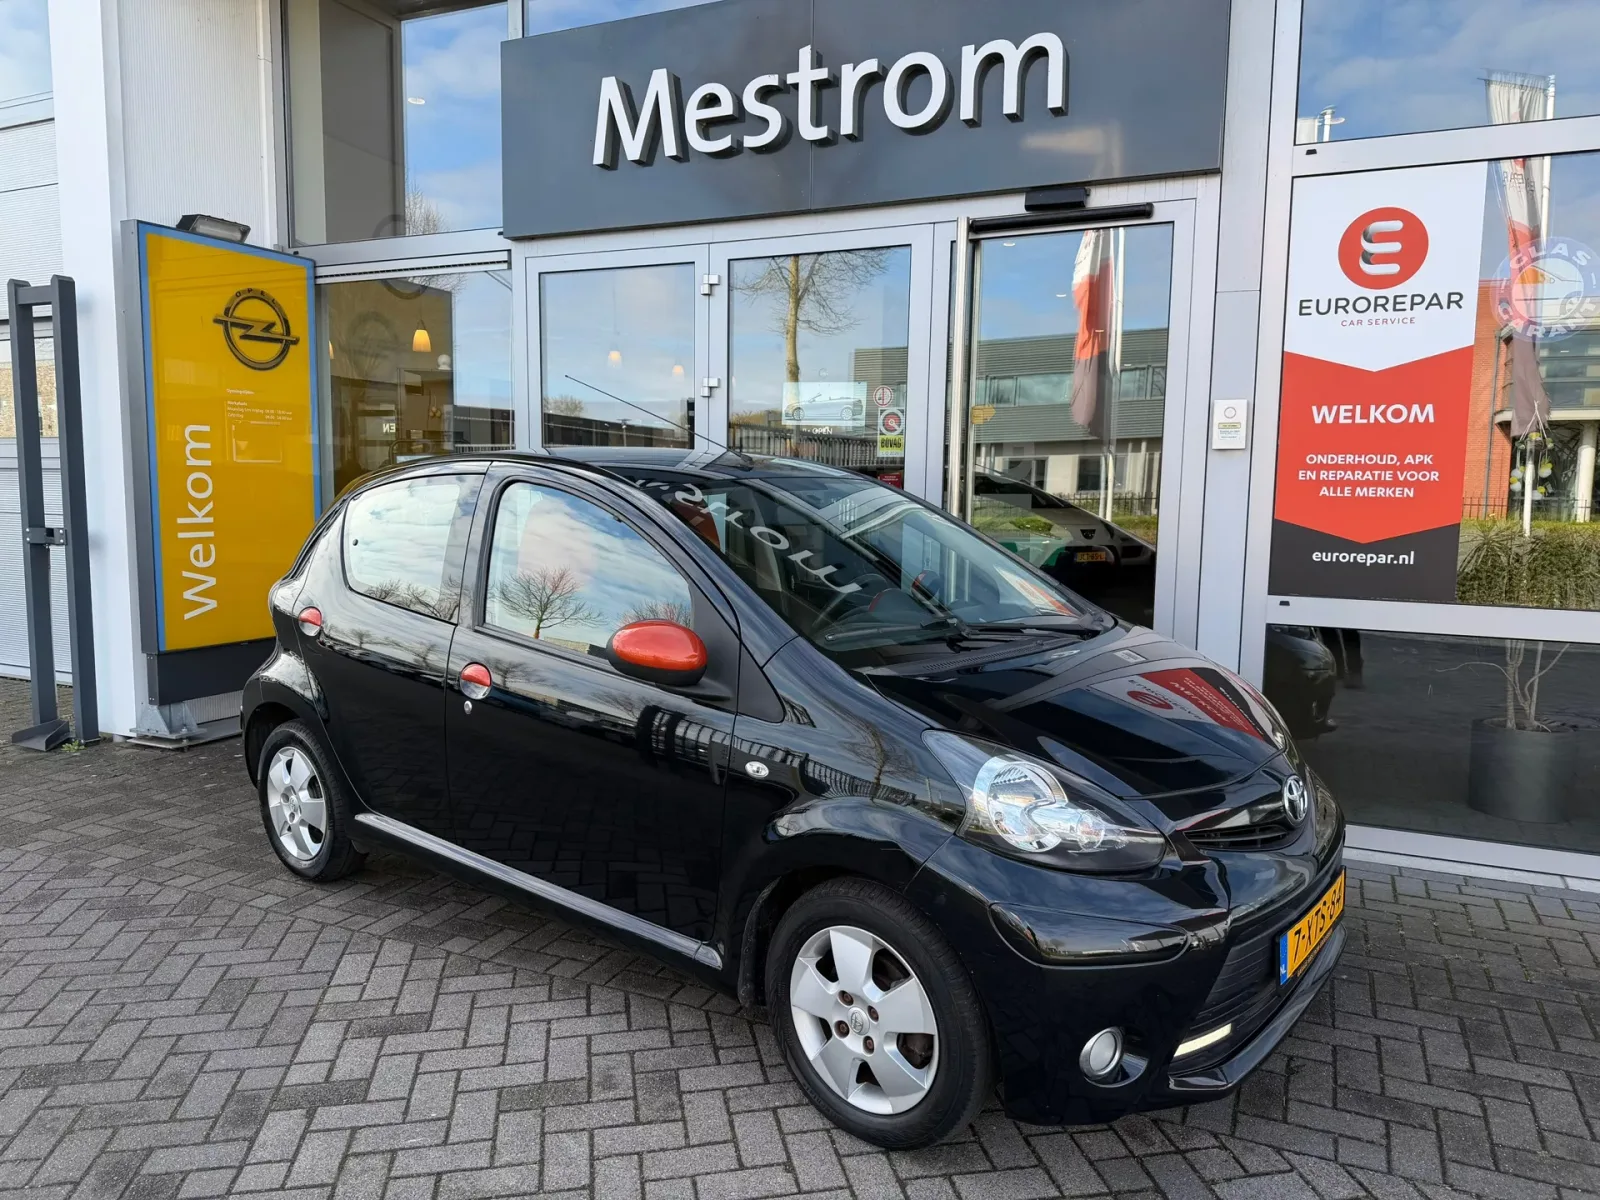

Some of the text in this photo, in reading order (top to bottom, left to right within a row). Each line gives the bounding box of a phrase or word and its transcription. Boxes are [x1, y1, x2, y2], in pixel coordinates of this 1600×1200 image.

[592, 32, 1067, 170] Mestrom
[1510, 243, 1591, 269] GLAS
[235, 287, 276, 304] OPEL
[1299, 292, 1464, 316] EUROREPAR
[1341, 317, 1416, 327] CAR SERVICE
[1311, 404, 1435, 424] WELKOM
[881, 438, 902, 448] BOVAG
[1306, 454, 1433, 466] ONDERHOUD, APK
[1298, 470, 1439, 481] EN REPARATIE VOOR
[1319, 486, 1414, 498] ALLE MERKEN
[176, 424, 218, 620] Welkom
[1312, 551, 1415, 567] eurorepar.nl
[1293, 878, 1342, 964] 7-XTS-84
